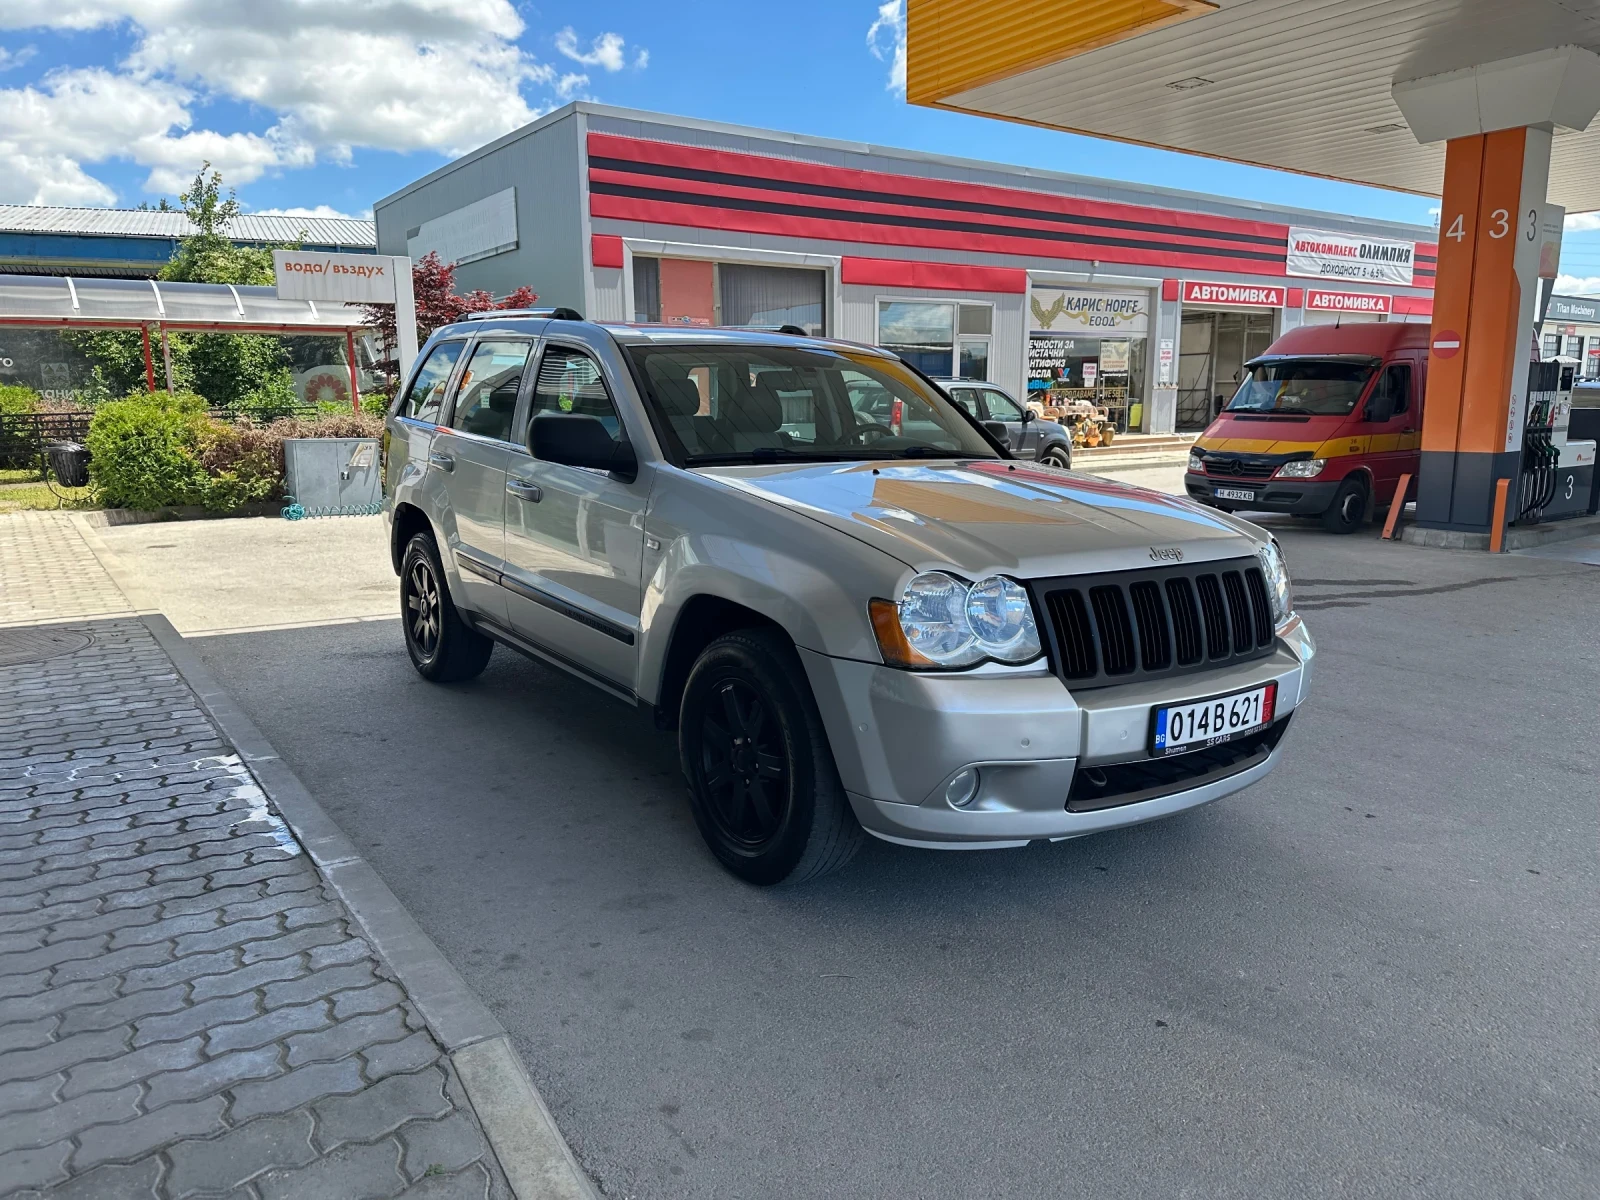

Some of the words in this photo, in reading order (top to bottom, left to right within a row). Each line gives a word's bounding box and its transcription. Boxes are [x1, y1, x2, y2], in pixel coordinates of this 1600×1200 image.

[1445, 213, 1466, 243] 4
[1489, 208, 1509, 239] 3
[1526, 209, 1537, 242] 3
[1294, 240, 1358, 258] АВТОКОМПЛЕКС
[1359, 243, 1411, 263] ОЛИМПИЯ
[1320, 263, 1361, 277] ДОХОДНОСТ
[1190, 285, 1278, 304] АВТОМИВКА
[1312, 294, 1384, 311] АВТОМИВКА
[1066, 297, 1103, 312] КАРИС
[1104, 299, 1139, 313] НОРГЕ
[1556, 302, 1570, 314] Titan
[1570, 304, 1596, 319] Machinery
[1089, 316, 1116, 327] ЕООД
[1028, 340, 1064, 349] ЕЧНОСТИ
[1064, 341, 1075, 349] ЗА
[1027, 379, 1052, 390] dBlue
[1565, 475, 1574, 500] 3
[1149, 546, 1184, 562] Jeep
[1155, 733, 1166, 744] BG
